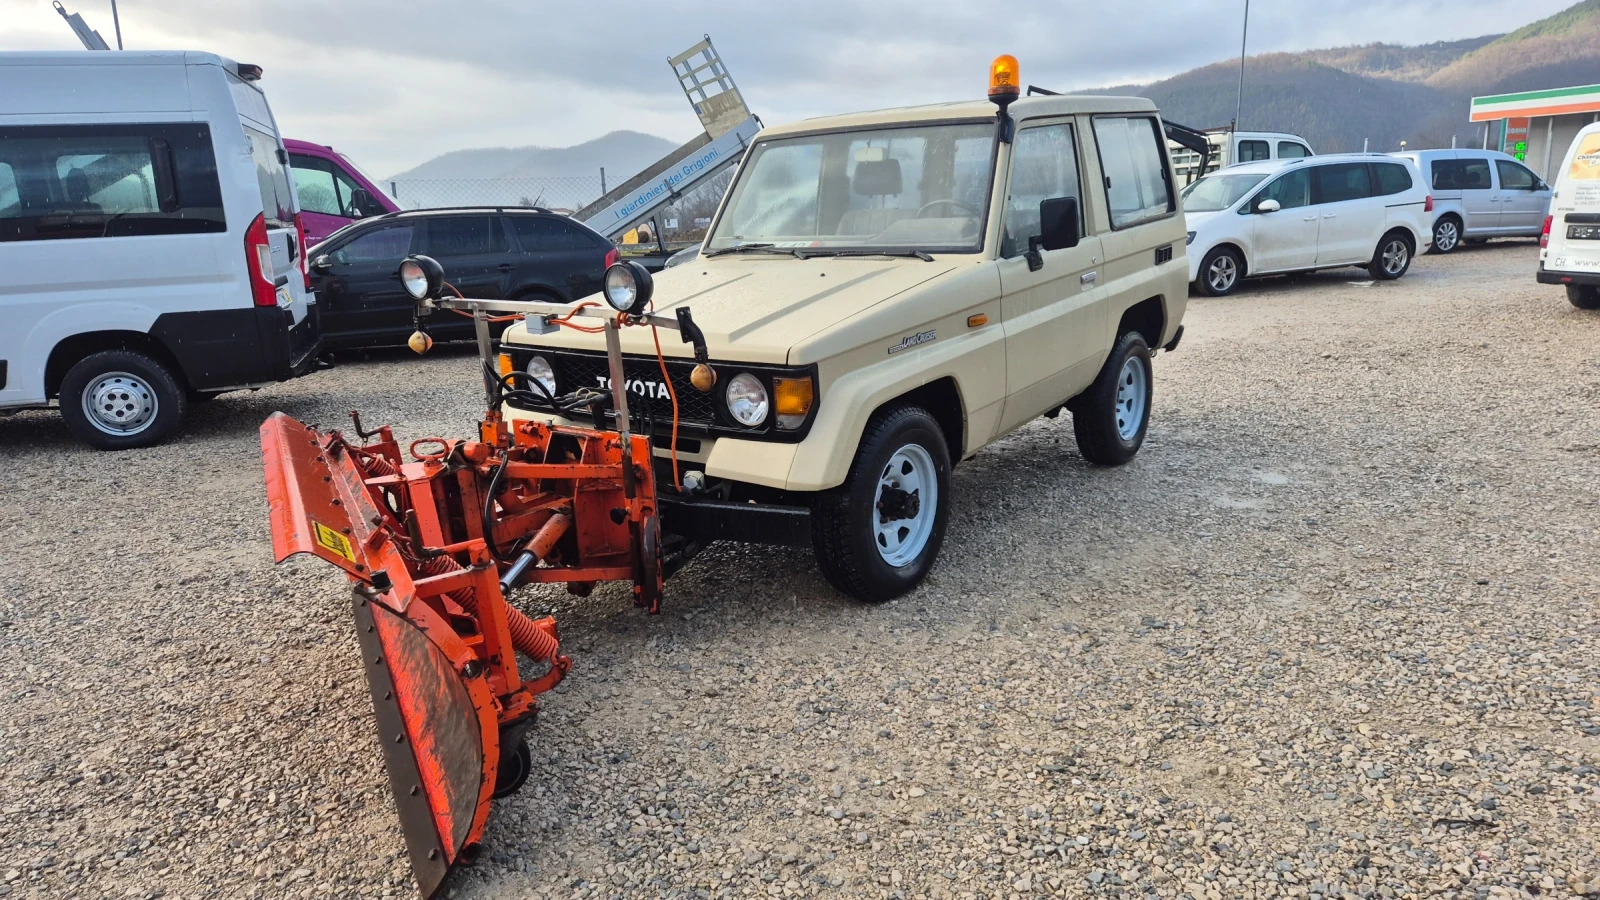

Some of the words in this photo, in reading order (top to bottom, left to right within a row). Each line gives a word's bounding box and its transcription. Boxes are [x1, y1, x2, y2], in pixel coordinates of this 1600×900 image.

[614, 210, 620, 219] I
[620, 180, 669, 217] giardinieri
[668, 170, 683, 186] dei
[1554, 257, 1567, 267] CH
